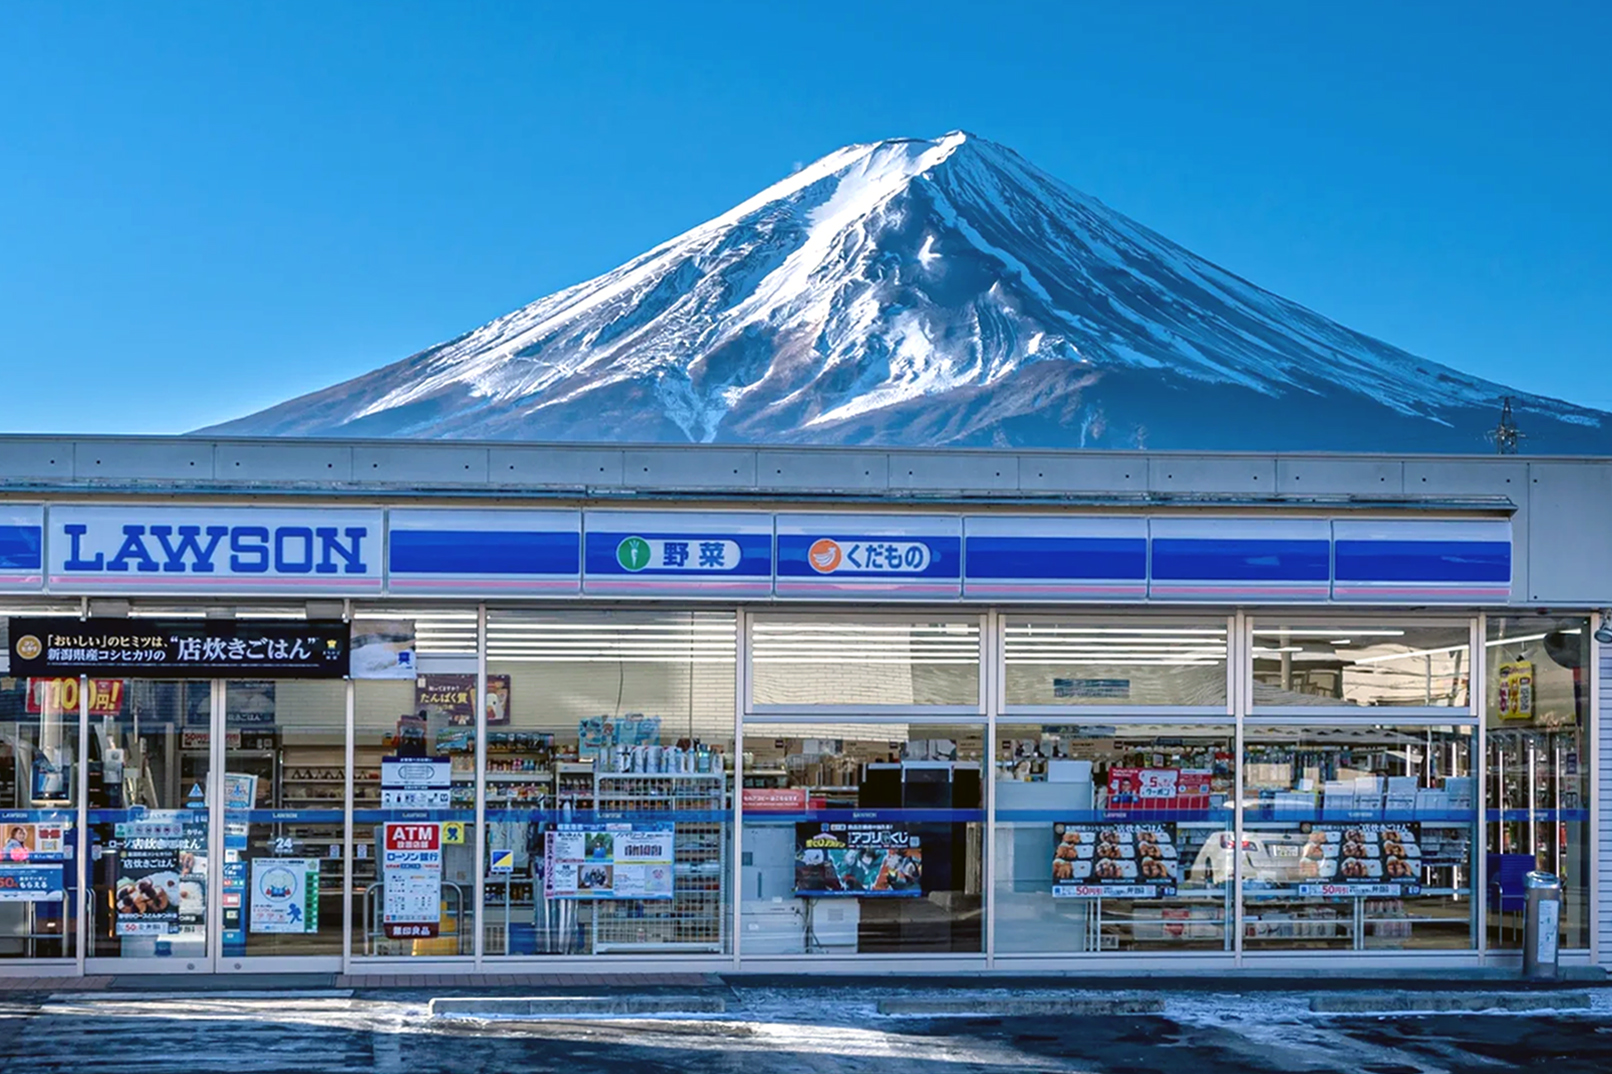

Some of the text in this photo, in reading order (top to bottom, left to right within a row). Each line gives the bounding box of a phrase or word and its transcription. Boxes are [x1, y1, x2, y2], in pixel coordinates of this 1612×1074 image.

[63, 524, 367, 573] LAWSON
[662, 542, 726, 568] 野菜
[846, 544, 924, 569] くだもの
[47, 649, 166, 661] 新潟県産コシヒカリの
[392, 827, 432, 840] ATM
[275, 837, 293, 849] 24
[387, 852, 439, 861] ローソン銀行
[392, 926, 431, 936] 無印良品
